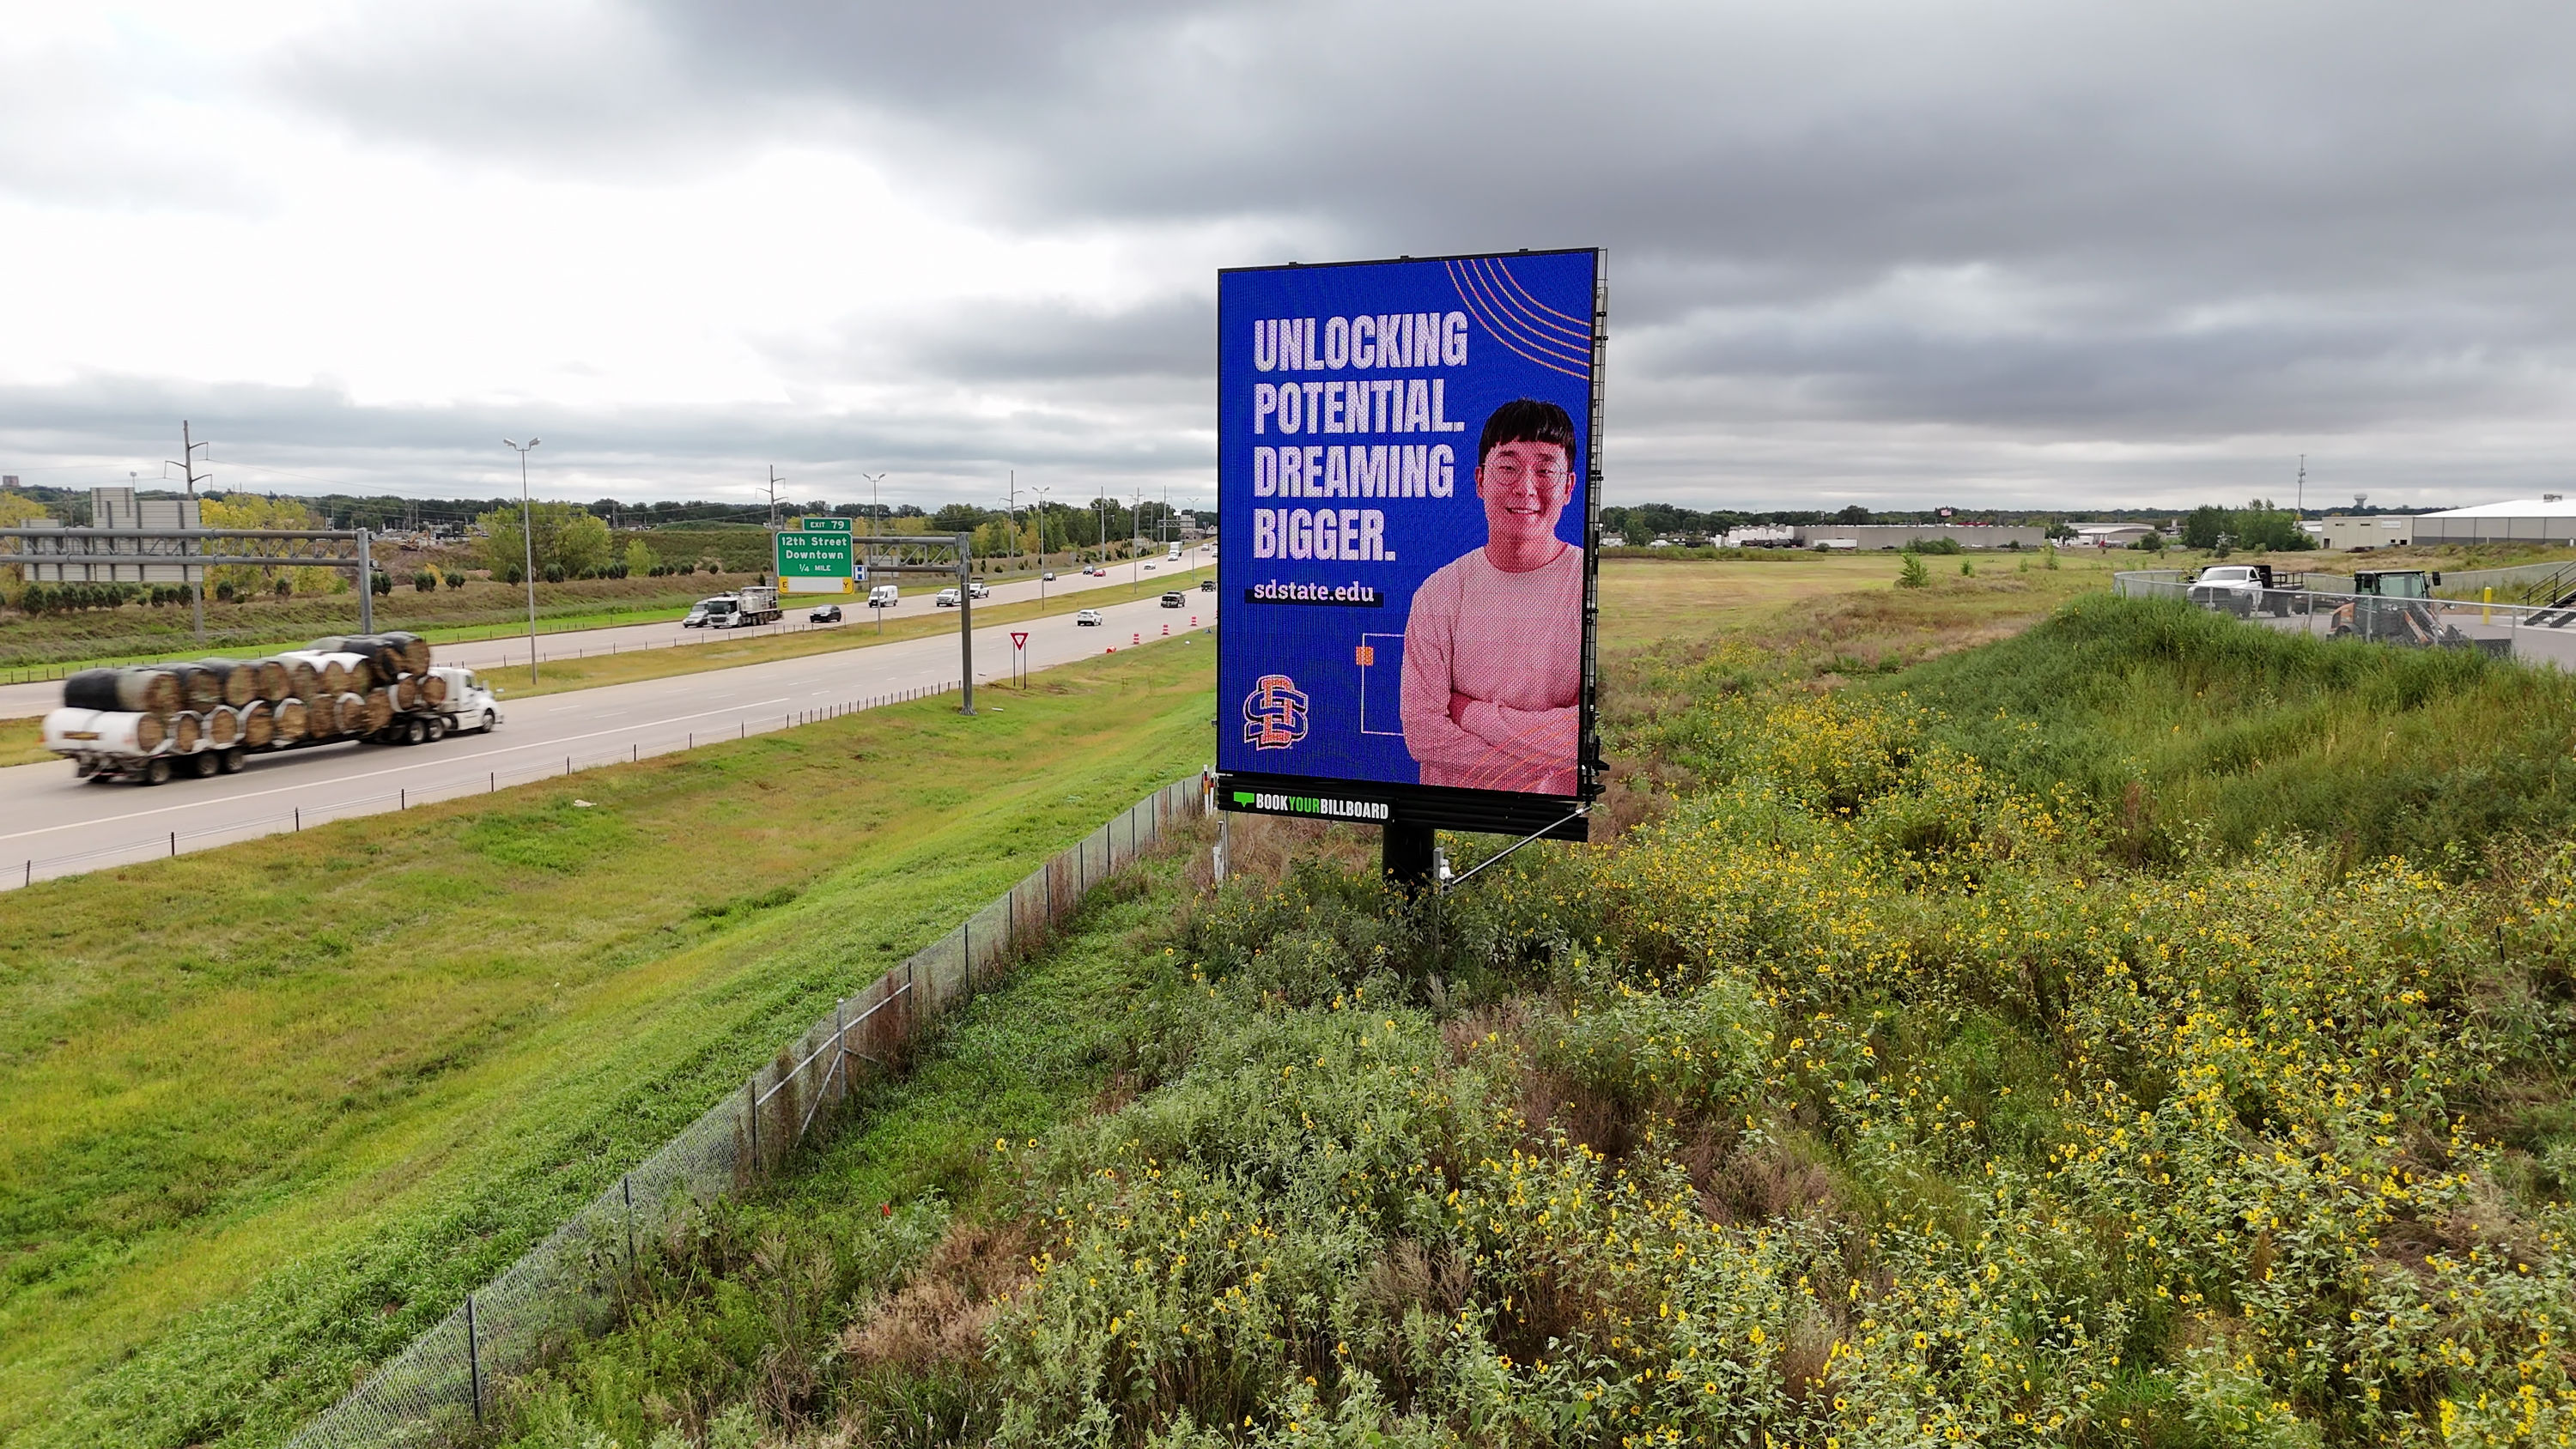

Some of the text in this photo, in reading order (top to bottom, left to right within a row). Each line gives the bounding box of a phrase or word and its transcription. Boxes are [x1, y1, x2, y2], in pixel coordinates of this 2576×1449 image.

[1254, 311, 1467, 372] UNLOCKING
[1254, 379, 1465, 434] POTENTIAL.
[1254, 444, 1455, 498] DREAMING
[831, 520, 845, 530] 79
[1253, 508, 1396, 561] BIGGER.
[781, 537, 847, 546] 12th Street
[786, 550, 844, 560] Downtown
[1254, 579, 1374, 602] sdstate.edu
[1256, 793, 1388, 820] BOOKYOURBILLBOARD
